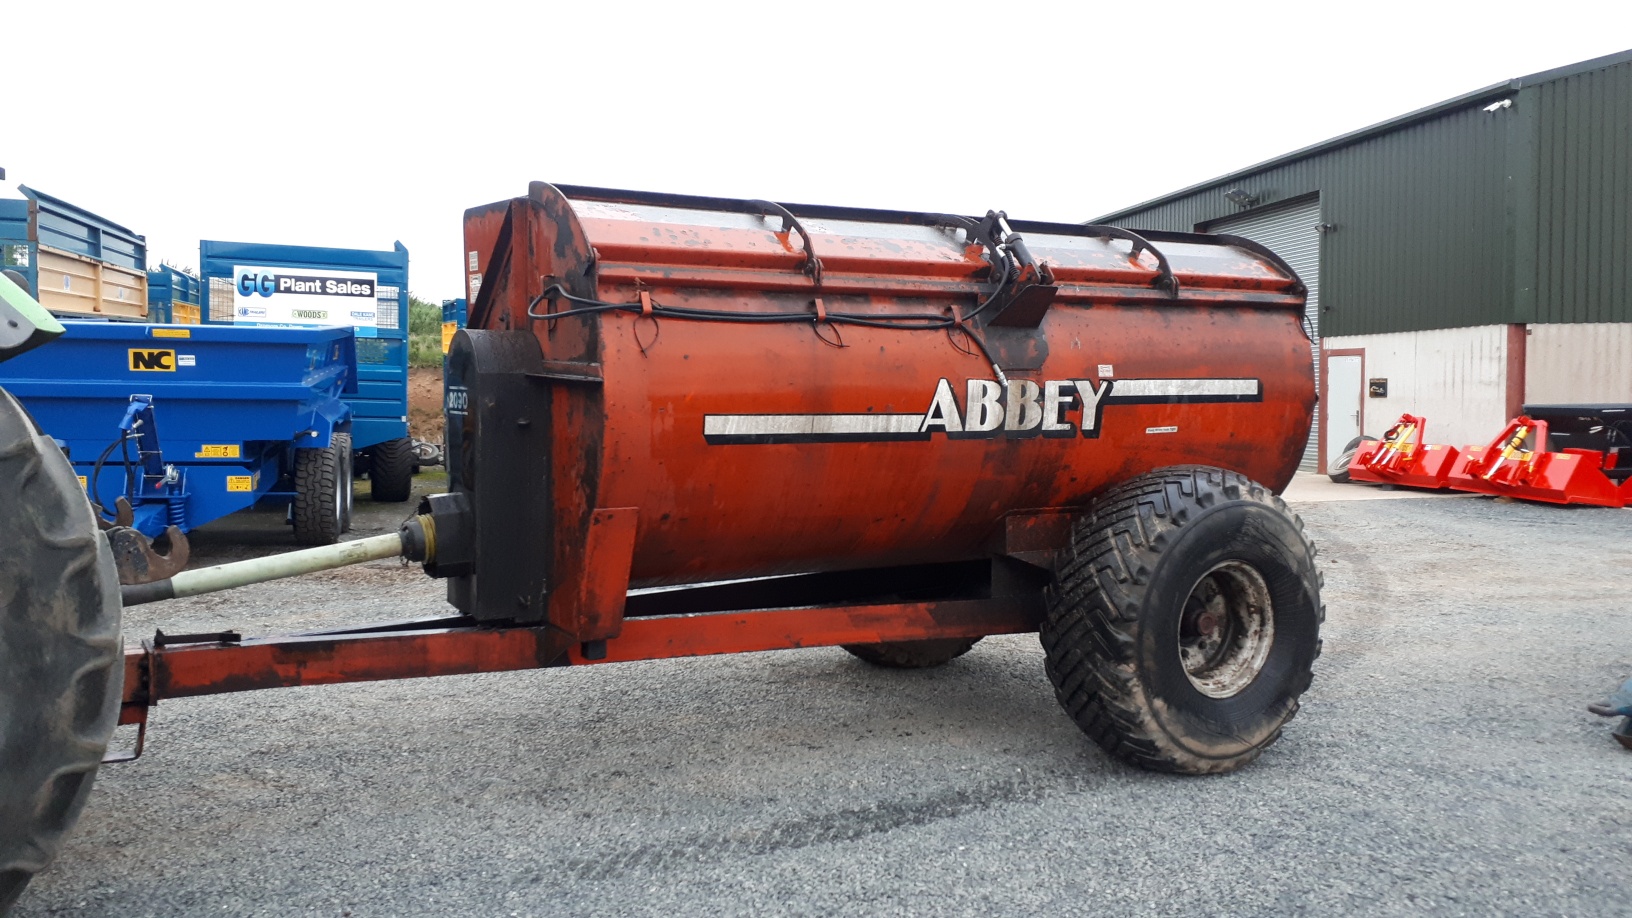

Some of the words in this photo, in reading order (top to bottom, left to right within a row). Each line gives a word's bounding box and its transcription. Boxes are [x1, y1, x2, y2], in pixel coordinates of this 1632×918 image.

[236, 268, 276, 298] GG
[279, 278, 322, 293] Plant
[325, 280, 371, 295] Sales
[296, 310, 322, 319] WOODS
[132, 350, 172, 370] NC
[920, 377, 1110, 437] ABBEY
